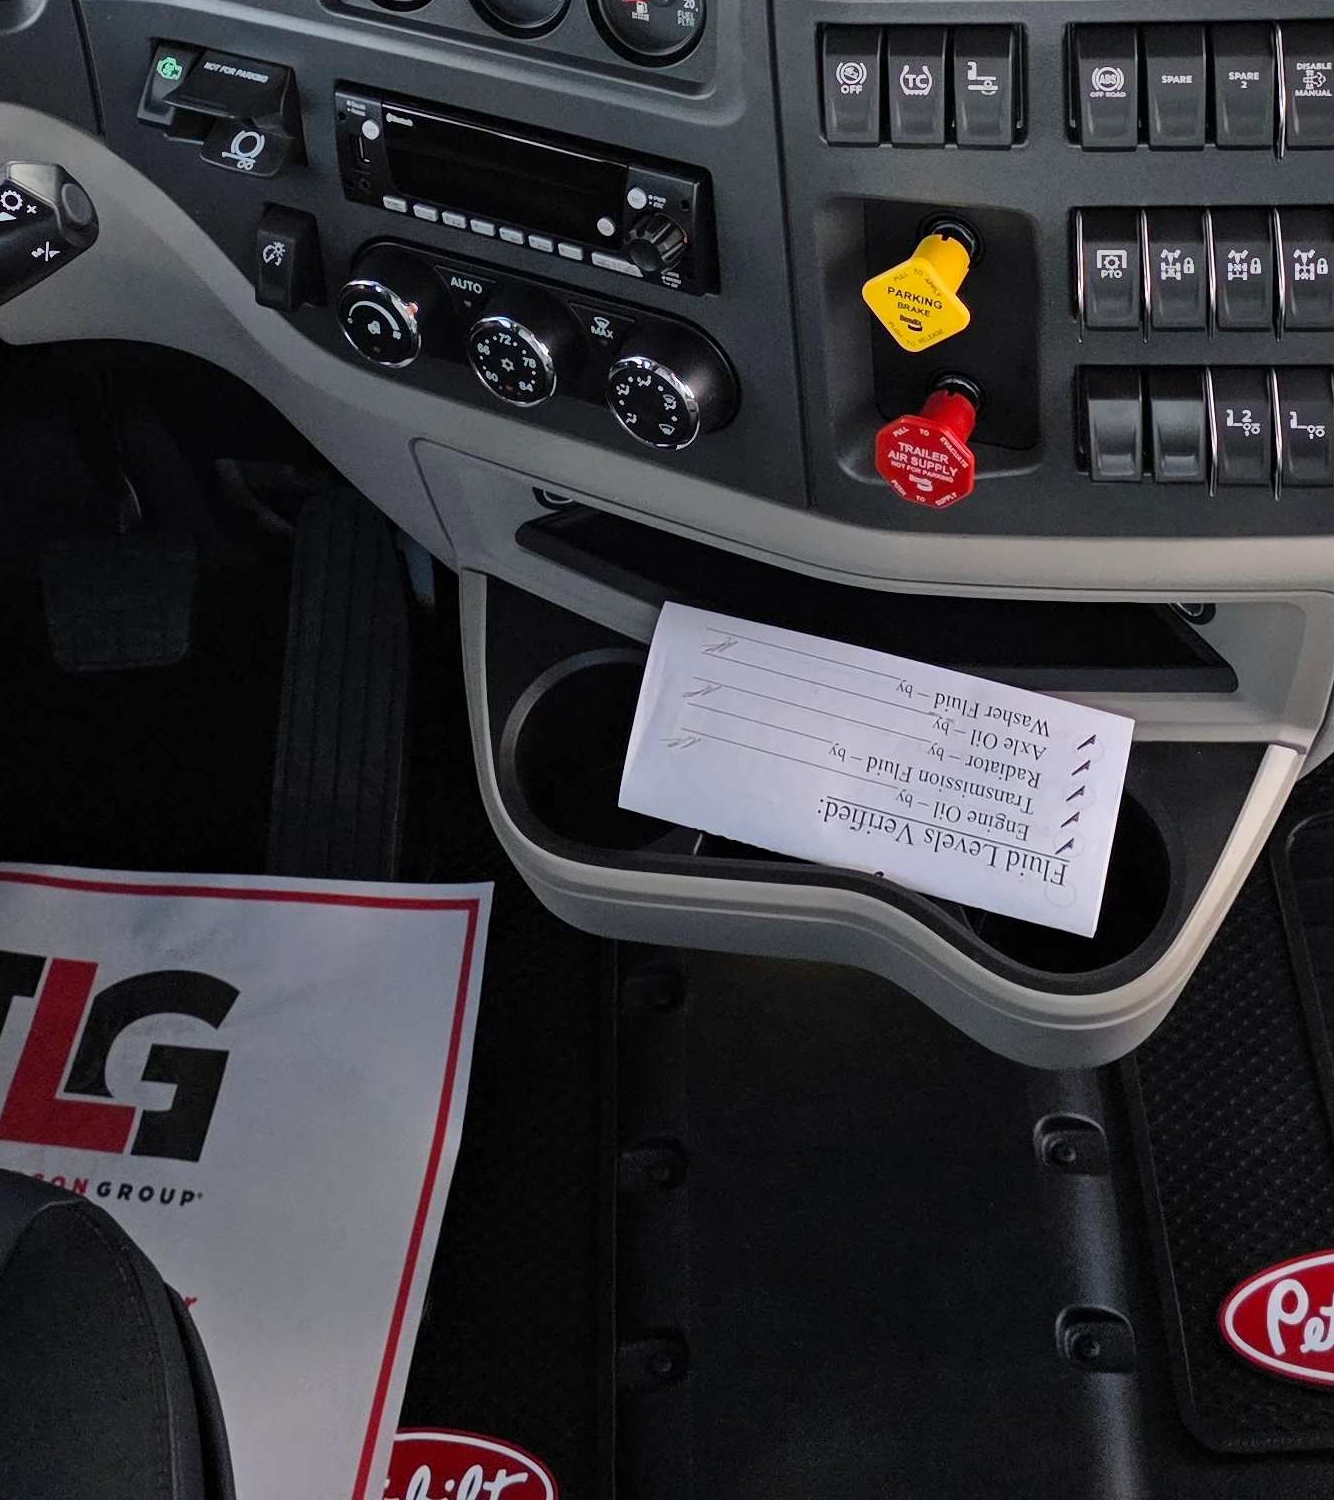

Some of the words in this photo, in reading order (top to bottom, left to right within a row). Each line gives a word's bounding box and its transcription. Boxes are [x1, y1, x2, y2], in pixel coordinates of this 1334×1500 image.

[677, 9, 696, 21] FUEL
[203, 61, 221, 73] NOT
[220, 65, 237, 76] FOR
[235, 68, 270, 84] PARKING
[1228, 71, 1260, 81] SPARE
[1296, 61, 1333, 71] DISABLE
[840, 84, 863, 95] OFF
[905, 74, 928, 89] TC
[1099, 74, 1117, 85] ABS
[1161, 75, 1193, 85] SPARE
[1240, 80, 1248, 89] 2
[1294, 88, 1333, 97] MANUAL
[892, 271, 910, 283] PULL
[913, 268, 924, 276] TO
[1100, 268, 1123, 279] PTO
[450, 276, 483, 295] AUTO
[887, 286, 943, 310] PARKING
[897, 301, 931, 317] BRAKE
[498, 332, 512, 346] 72
[590, 325, 614, 340] MAX
[917, 328, 945, 344] RELEASE
[485, 370, 499, 383] 60
[518, 380, 534, 392] 84
[897, 441, 949, 465] TRAILER
[919, 428, 930, 437] TO
[939, 436, 970, 469] EVACUATE
[887, 449, 908, 463] AIR
[910, 456, 959, 477] SUPPLY
[890, 460, 906, 469] NOT
[906, 464, 922, 474] FOR
[922, 469, 954, 483] PARKING
[915, 495, 926, 503] TO
[896, 679, 914, 699] by
[933, 691, 979, 719] Fluid
[932, 715, 950, 736] by
[983, 705, 1051, 739] Washer
[970, 726, 999, 750] Oil
[828, 742, 848, 762] by
[927, 741, 945, 761] by
[1002, 735, 1047, 762] Axle
[866, 756, 913, 783] Fluid
[966, 754, 1042, 790] Radiator
[895, 788, 913, 809] by
[917, 769, 1035, 816] Transmission
[818, 798, 914, 848] Verified:
[932, 801, 963, 825] Oil
[967, 809, 1030, 843] Engine
[923, 828, 999, 870] Levels
[1008, 849, 1069, 888] Fluid
